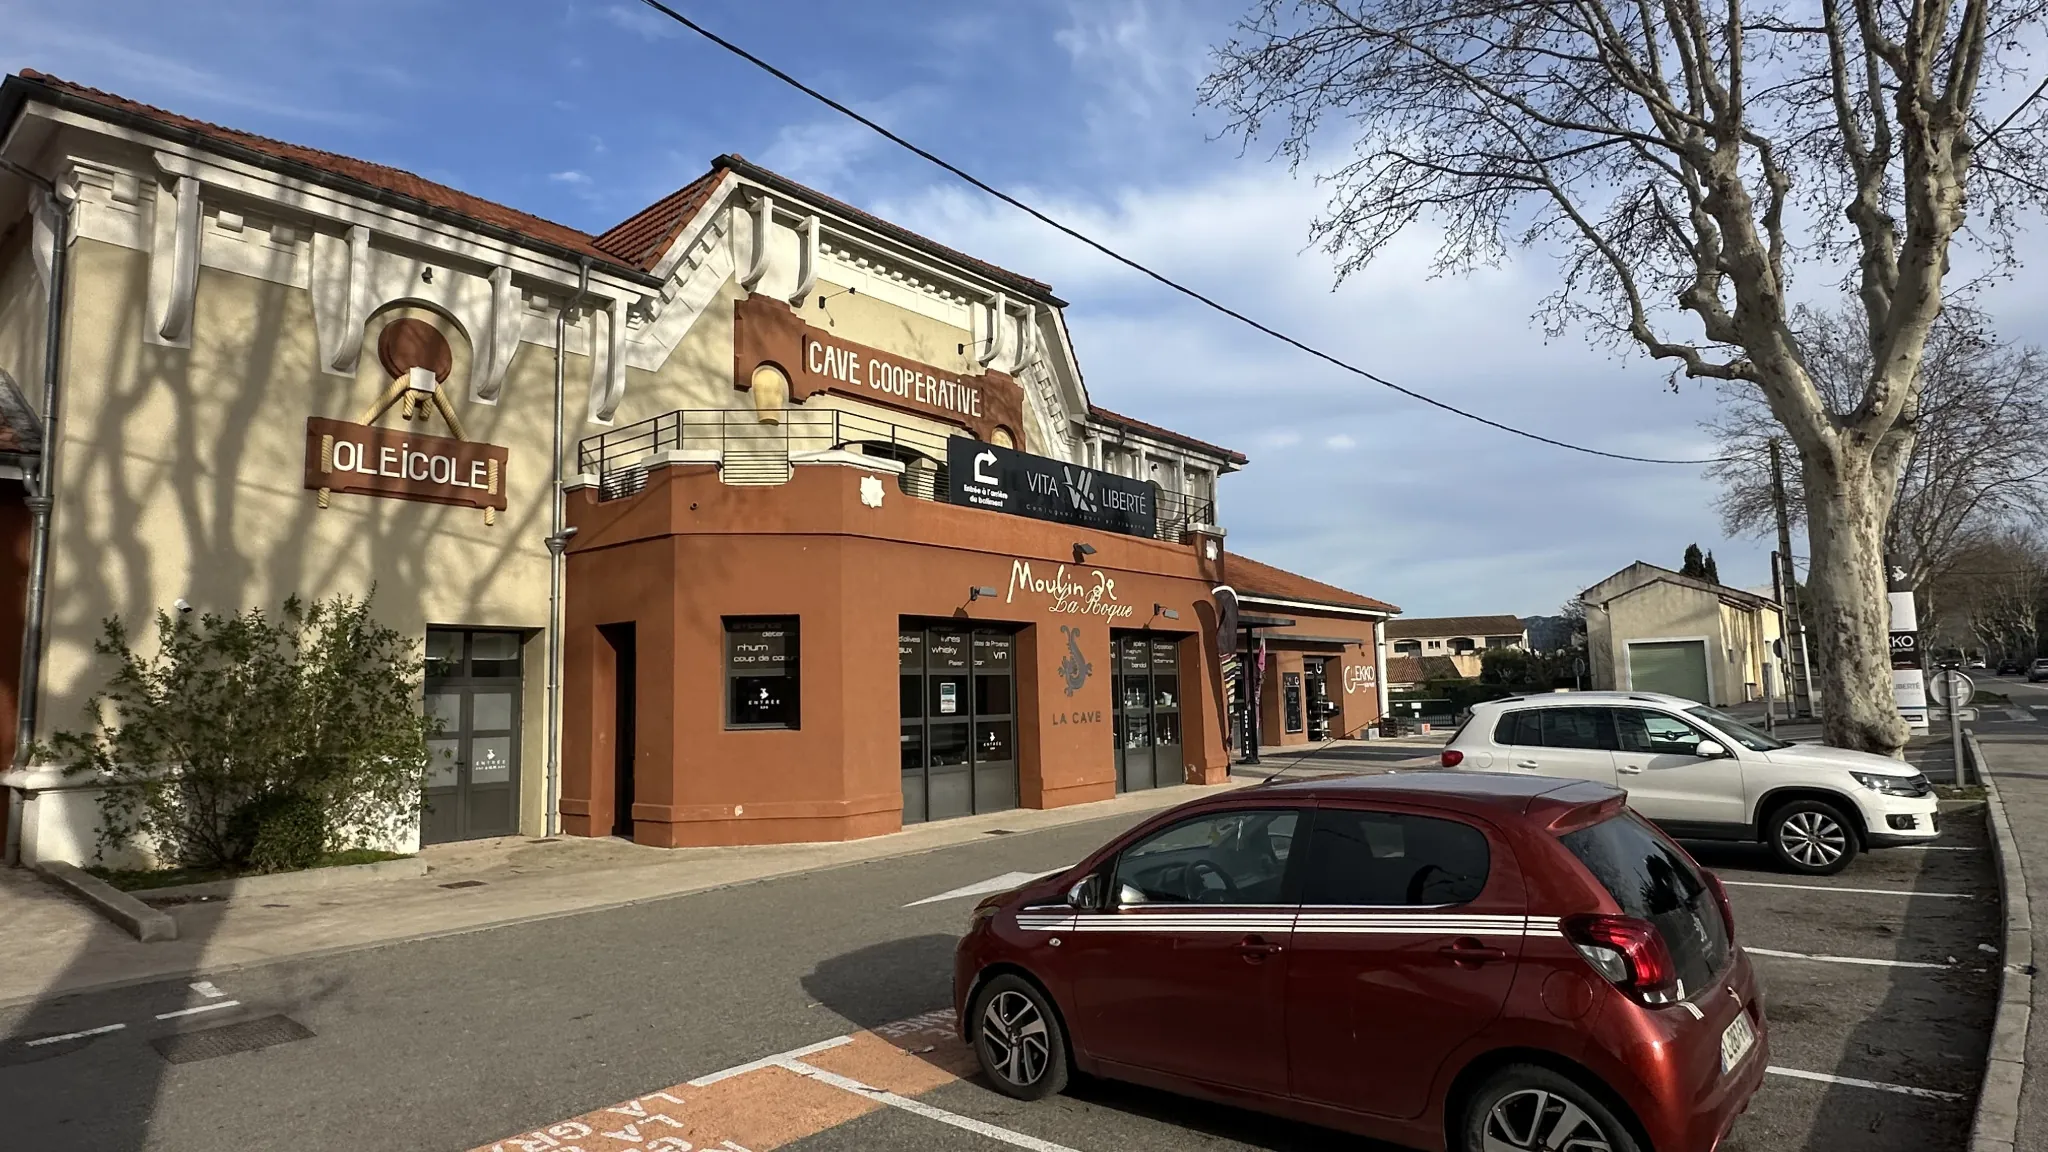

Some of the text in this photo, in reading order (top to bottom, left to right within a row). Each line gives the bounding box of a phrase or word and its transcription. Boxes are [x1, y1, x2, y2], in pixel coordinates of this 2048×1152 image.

[809, 340, 862, 386] CAVE
[963, 484, 981, 494] Entrée
[981, 487, 987, 496] à
[1026, 470, 1060, 498] VITA
[1102, 487, 1147, 515] LIBERTÉ
[969, 495, 978, 503] du
[1006, 559, 1118, 604] Moulin de
[1048, 585, 1133, 624] La Roque
[736, 643, 769, 652] rhum
[931, 645, 958, 656] whisky
[733, 655, 757, 663] coup
[758, 654, 770, 662] de
[993, 651, 1007, 660] vin
[1053, 711, 1102, 726] LA CAVE
